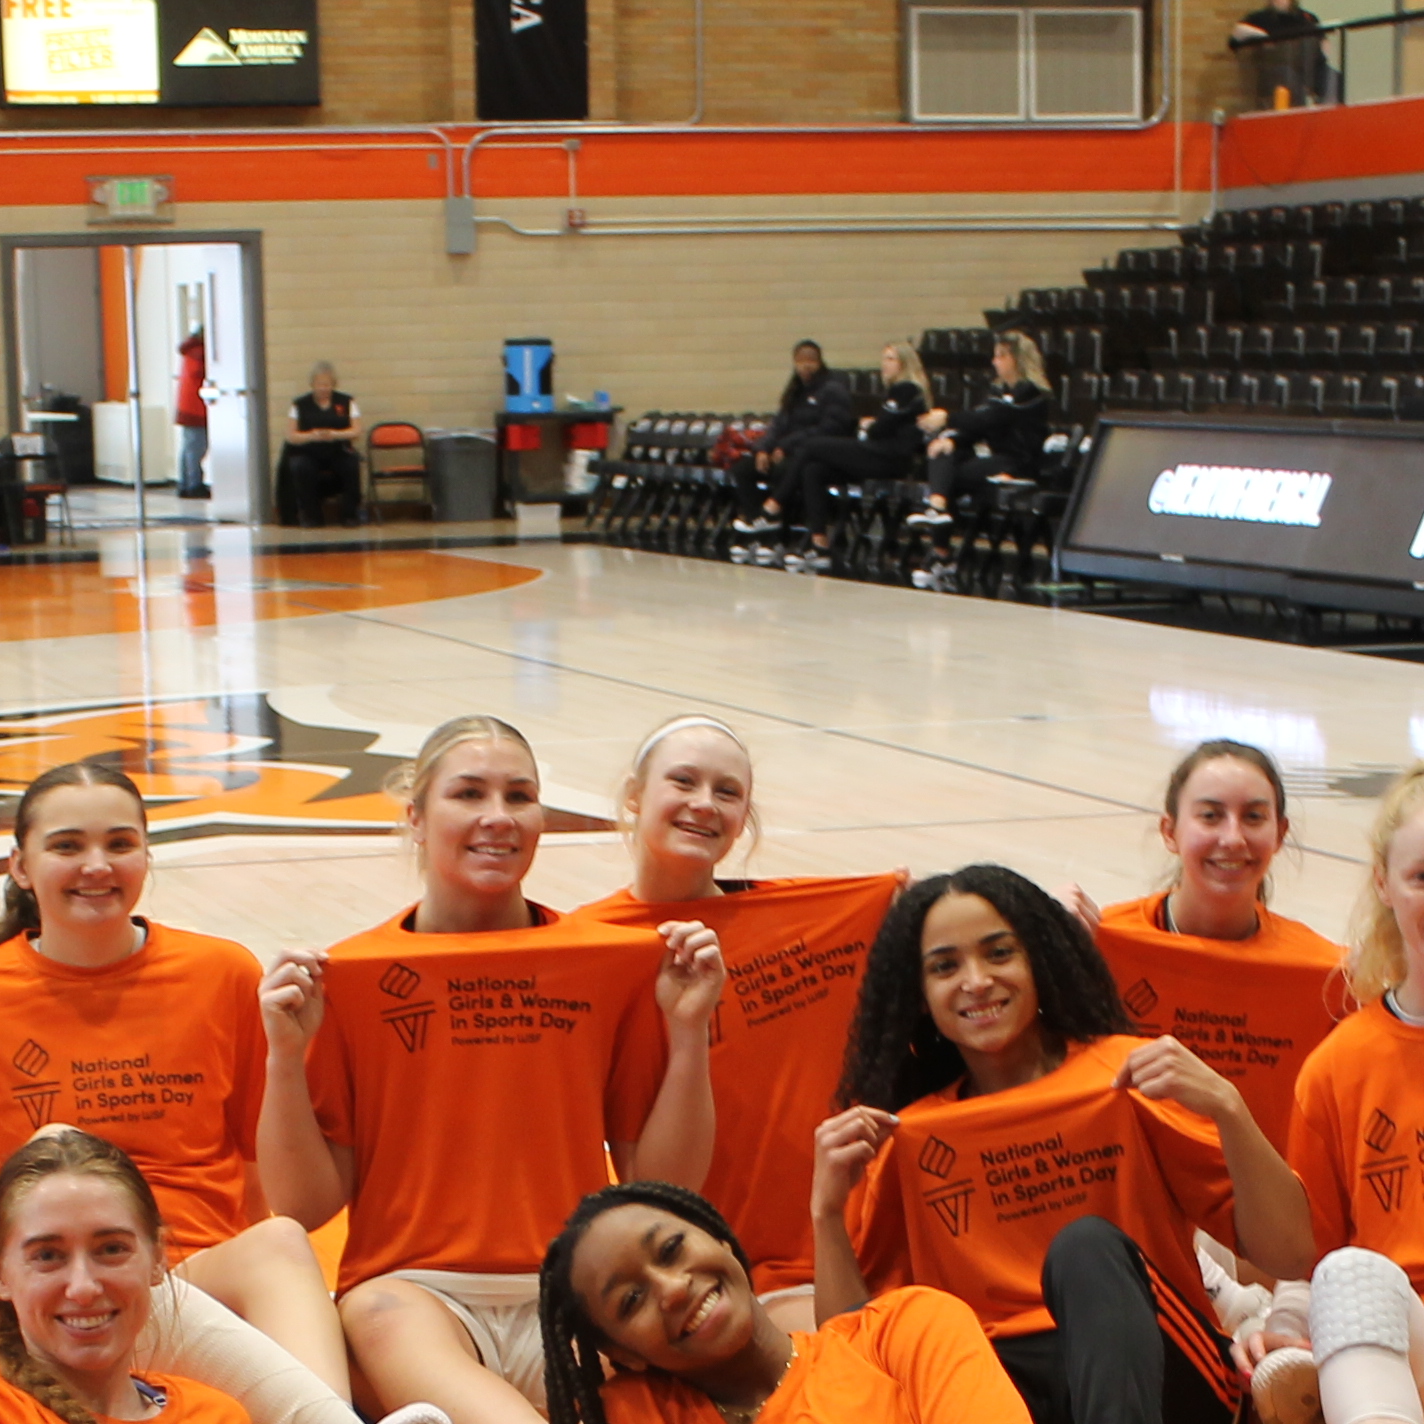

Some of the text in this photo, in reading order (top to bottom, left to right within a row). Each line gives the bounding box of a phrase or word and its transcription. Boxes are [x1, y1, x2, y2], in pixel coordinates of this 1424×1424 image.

[2, 0, 72, 19] FREE
[727, 937, 807, 980] National
[735, 940, 866, 996] Girls & Women
[447, 975, 536, 992] National
[740, 961, 856, 1014] in Sports Day
[449, 994, 591, 1012] Girls & Women
[450, 1012, 576, 1033] in Sports Day
[1175, 1008, 1247, 1027] National
[1172, 1024, 1294, 1049] Girls & Women
[71, 1053, 150, 1073] National
[1247, 1048, 1279, 1068] Day
[73, 1071, 204, 1091] Girls & Women
[76, 1088, 193, 1110] in Sports Day
[981, 1132, 1063, 1167] National
[986, 1143, 1124, 1187] Girls & Women
[991, 1165, 1117, 1206] in Sports Day
